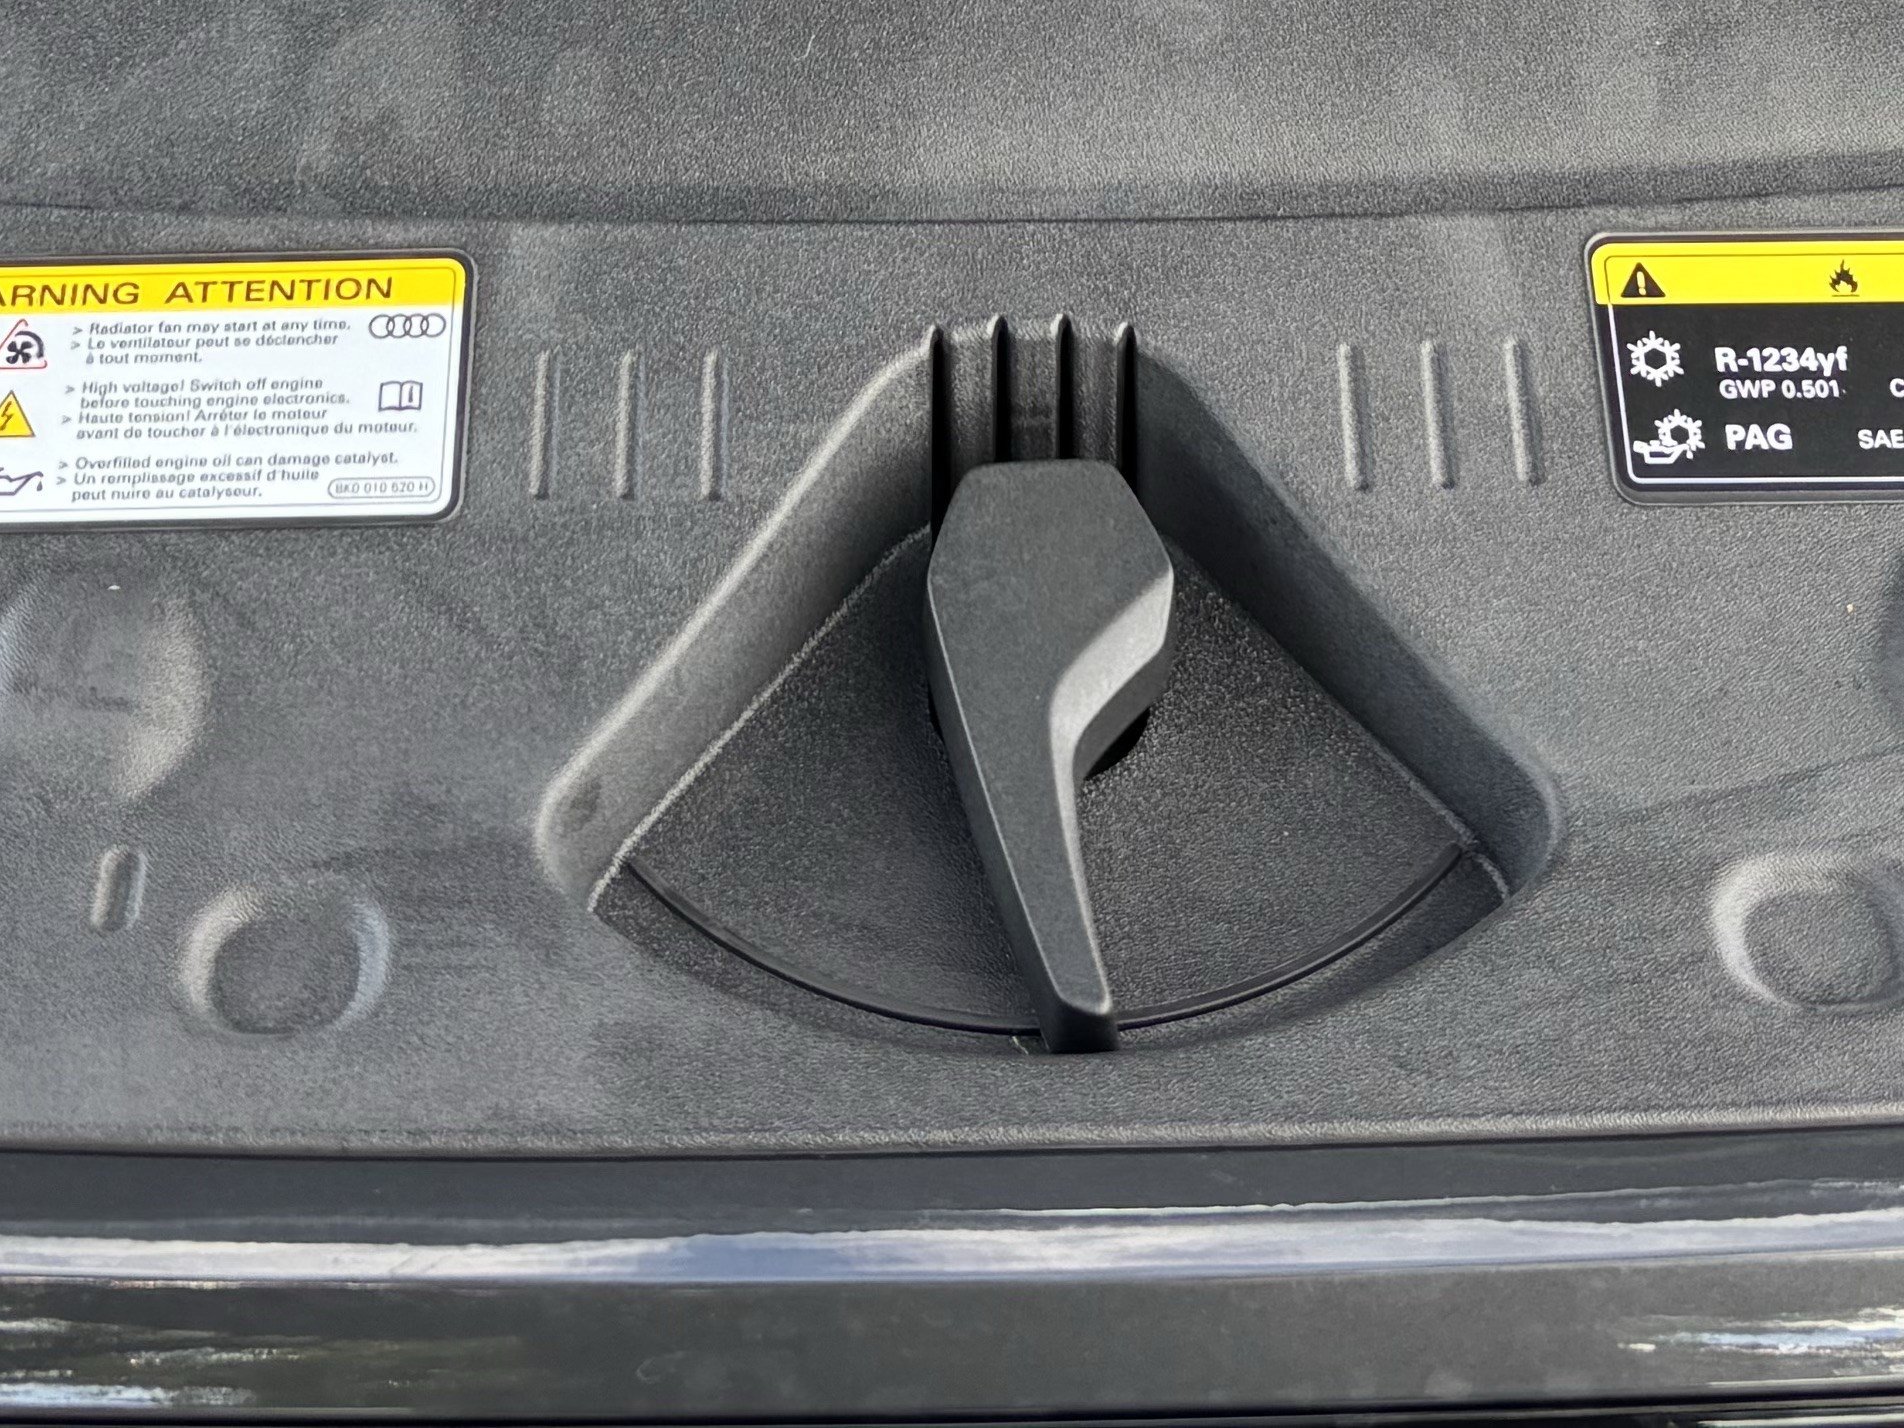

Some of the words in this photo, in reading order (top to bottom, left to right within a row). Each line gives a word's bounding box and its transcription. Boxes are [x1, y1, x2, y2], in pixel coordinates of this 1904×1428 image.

[164, 276, 393, 305] ATTENTION
[89, 323, 153, 335] Radiator
[158, 322, 181, 334] fan
[186, 323, 219, 334] may
[224, 321, 257, 332] start
[263, 321, 276, 332] at
[282, 321, 308, 333] any
[87, 338, 104, 350] Le
[196, 336, 229, 350] peut
[234, 337, 250, 346] se
[100, 352, 129, 364] tout
[134, 352, 202, 363] moment.
[1714, 345, 1848, 376] R-1234yf
[82, 382, 117, 394] High
[190, 378, 240, 392] Switch
[246, 378, 266, 390] off
[272, 379, 323, 392] engine
[1719, 379, 1776, 399] GWP
[1782, 379, 1839, 398] 0.501
[80, 395, 129, 408] before
[134, 394, 201, 408] touching
[207, 394, 258, 407] engine
[78, 412, 123, 424] Haute
[254, 409, 266, 420] le
[272, 408, 327, 420] moteur
[76, 426, 118, 440] avant
[124, 426, 142, 438] de
[148, 425, 206, 437] toucher
[334, 421, 354, 435] du
[1725, 424, 1793, 450] PAG
[1858, 429, 1904, 449] SAE
[75, 456, 150, 471] Overfilled
[155, 456, 208, 470] engine
[213, 454, 231, 467] oil
[236, 455, 263, 466] can
[267, 453, 330, 468] damage
[334, 451, 398, 465] catalyst.
[73, 472, 96, 485] Un
[102, 471, 194, 486] remplissage
[200, 469, 262, 482] excessif
[71, 489, 105, 503] peut
[111, 487, 151, 501] nuire
[157, 488, 175, 500] au
